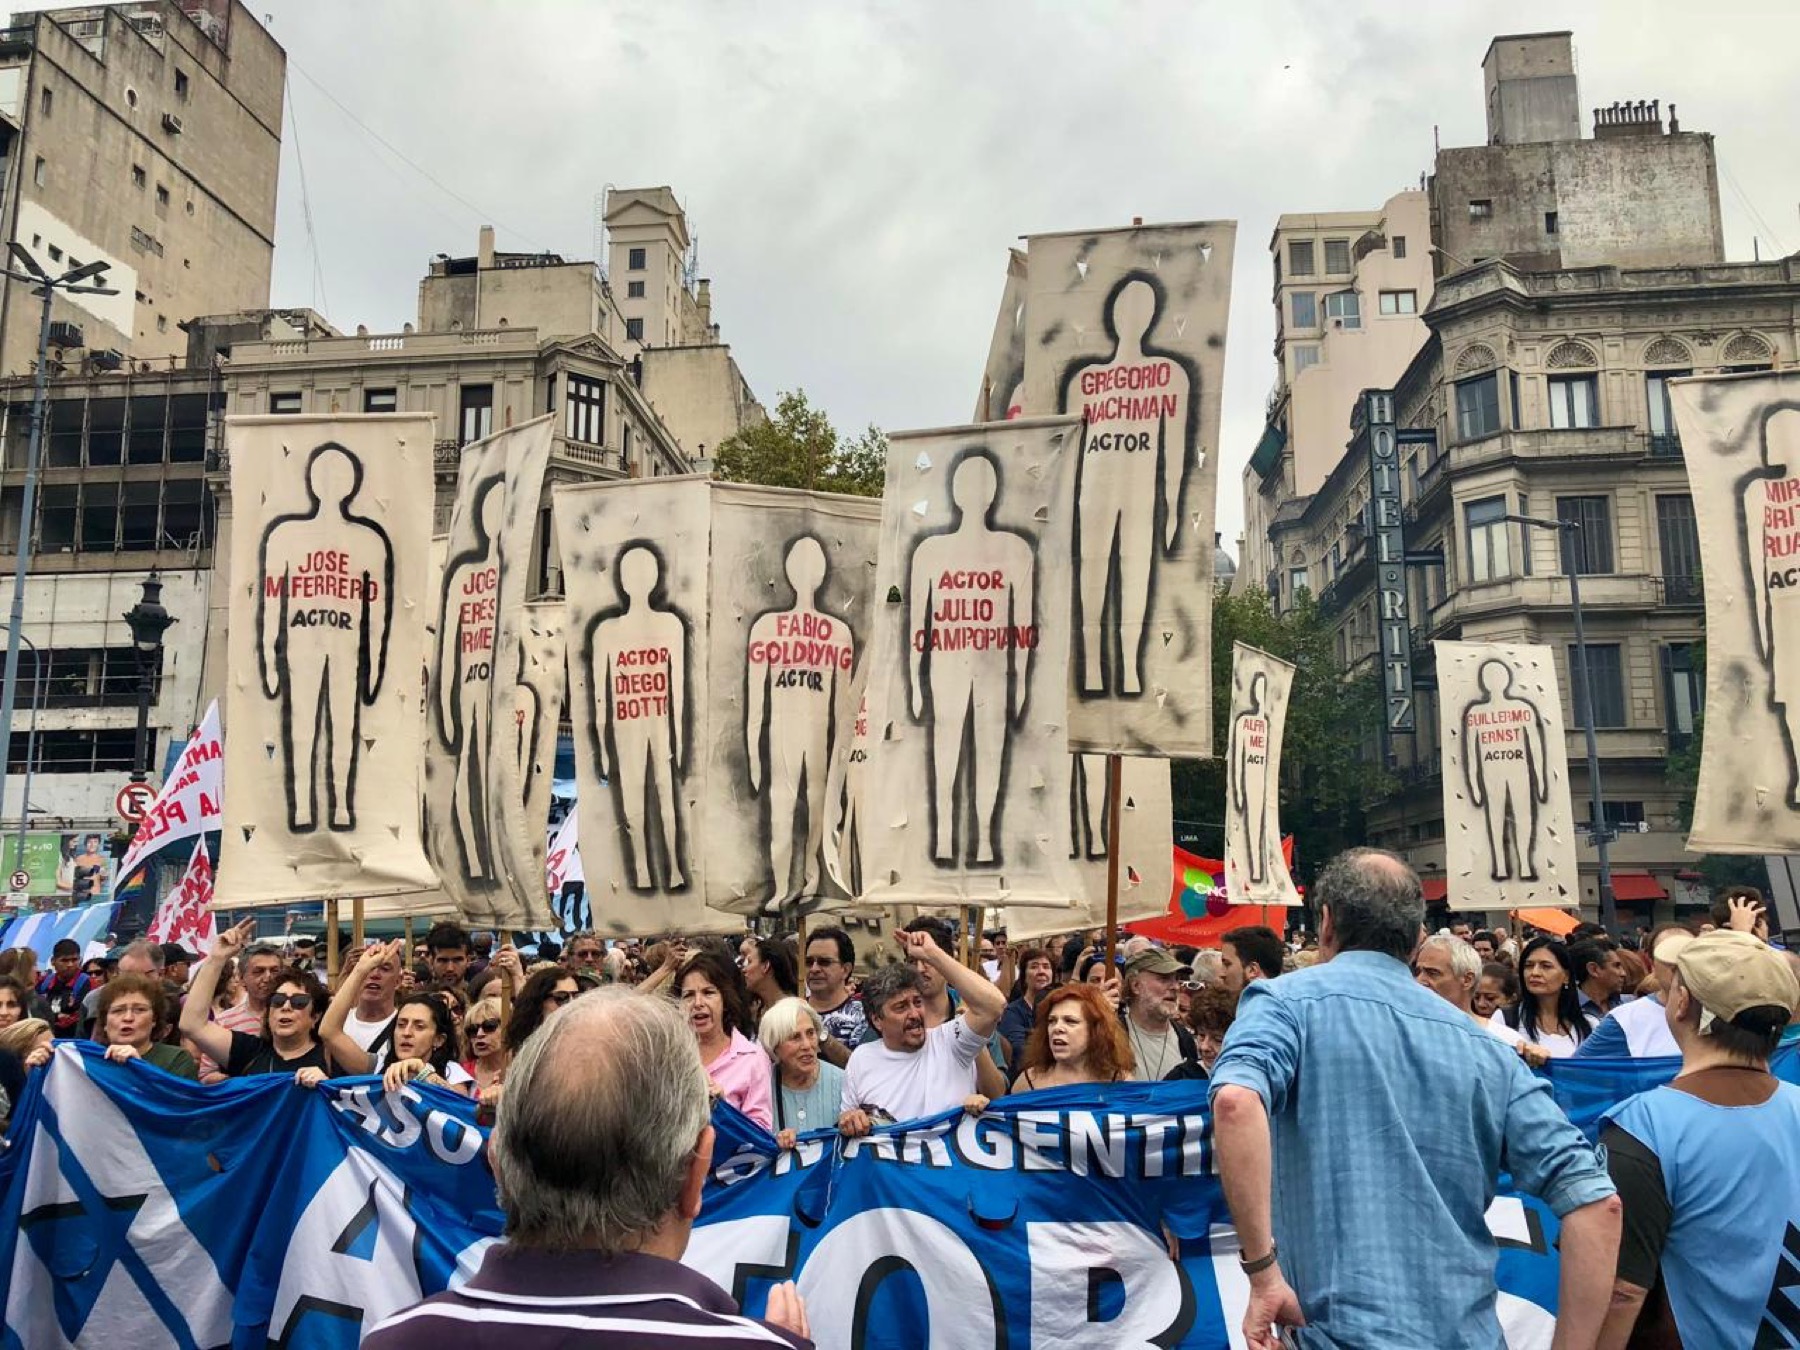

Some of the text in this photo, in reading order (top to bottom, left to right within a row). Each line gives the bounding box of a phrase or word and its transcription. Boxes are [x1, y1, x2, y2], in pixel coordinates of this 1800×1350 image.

[1081, 362, 1171, 395] GREGORIO
[1083, 394, 1177, 424] NACHMAN
[1087, 432, 1151, 454] ACTOR
[1764, 504, 1800, 529] BRI
[298, 550, 349, 575] JOSE
[1370, 395, 1411, 729] HOTEL RITZ
[938, 569, 1005, 590] ACTOR
[1768, 567, 1800, 589] AC
[290, 609, 353, 630] ACTOR
[934, 598, 993, 622] JULIO
[776, 613, 832, 640] FABIO
[616, 647, 668, 667] ACTOR
[615, 672, 666, 696] DIEGO
[775, 669, 823, 691] ACTOR
[1481, 728, 1520, 744] ERNST
[1484, 749, 1524, 761] ACTOR
[844, 1109, 1220, 1178] ARGENTI
